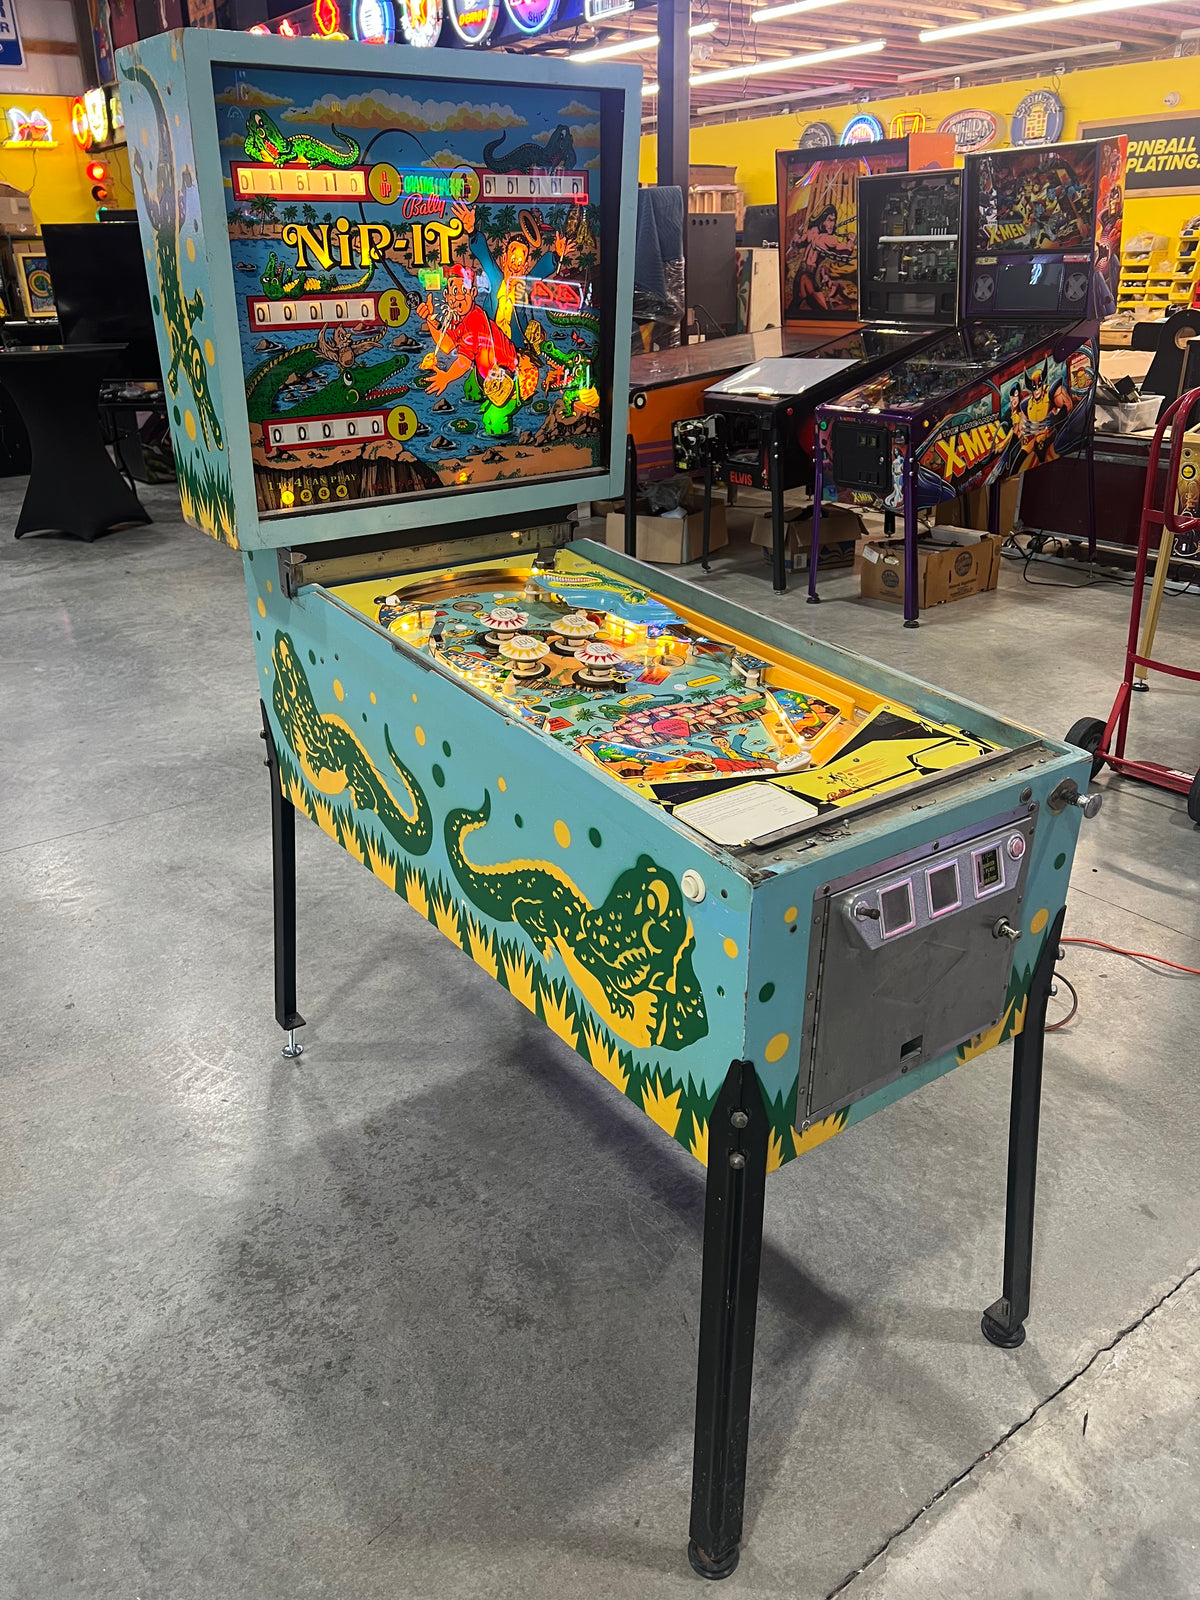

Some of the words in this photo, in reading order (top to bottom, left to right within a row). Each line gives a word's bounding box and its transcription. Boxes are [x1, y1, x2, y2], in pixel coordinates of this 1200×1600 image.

[1126, 136, 1197, 157] PINBALL
[379, 182, 392, 198] UP
[402, 192, 446, 220] Bally
[984, 222, 1028, 249] X-MEN
[390, 296, 398, 307] 2
[389, 307, 401, 322] UP
[398, 412, 406, 423] 3
[398, 422, 409, 436] UP
[942, 426, 959, 438] THE
[935, 420, 1007, 479] X-MEN
[268, 481, 274, 491] 1
[276, 481, 291, 490] TO
[294, 477, 302, 487] 4
[306, 477, 327, 486] CAN
[330, 473, 357, 484] PLAY
[459, 471, 468, 482] 2
[729, 470, 753, 486] ELVIS
[302, 491, 310, 499] 2
[320, 489, 328, 497] 3
[338, 487, 345, 495] 4
[496, 609, 513, 618] 100
[568, 615, 584, 623] 100
[515, 637, 534, 647] 100
[592, 645, 610, 654] 100
